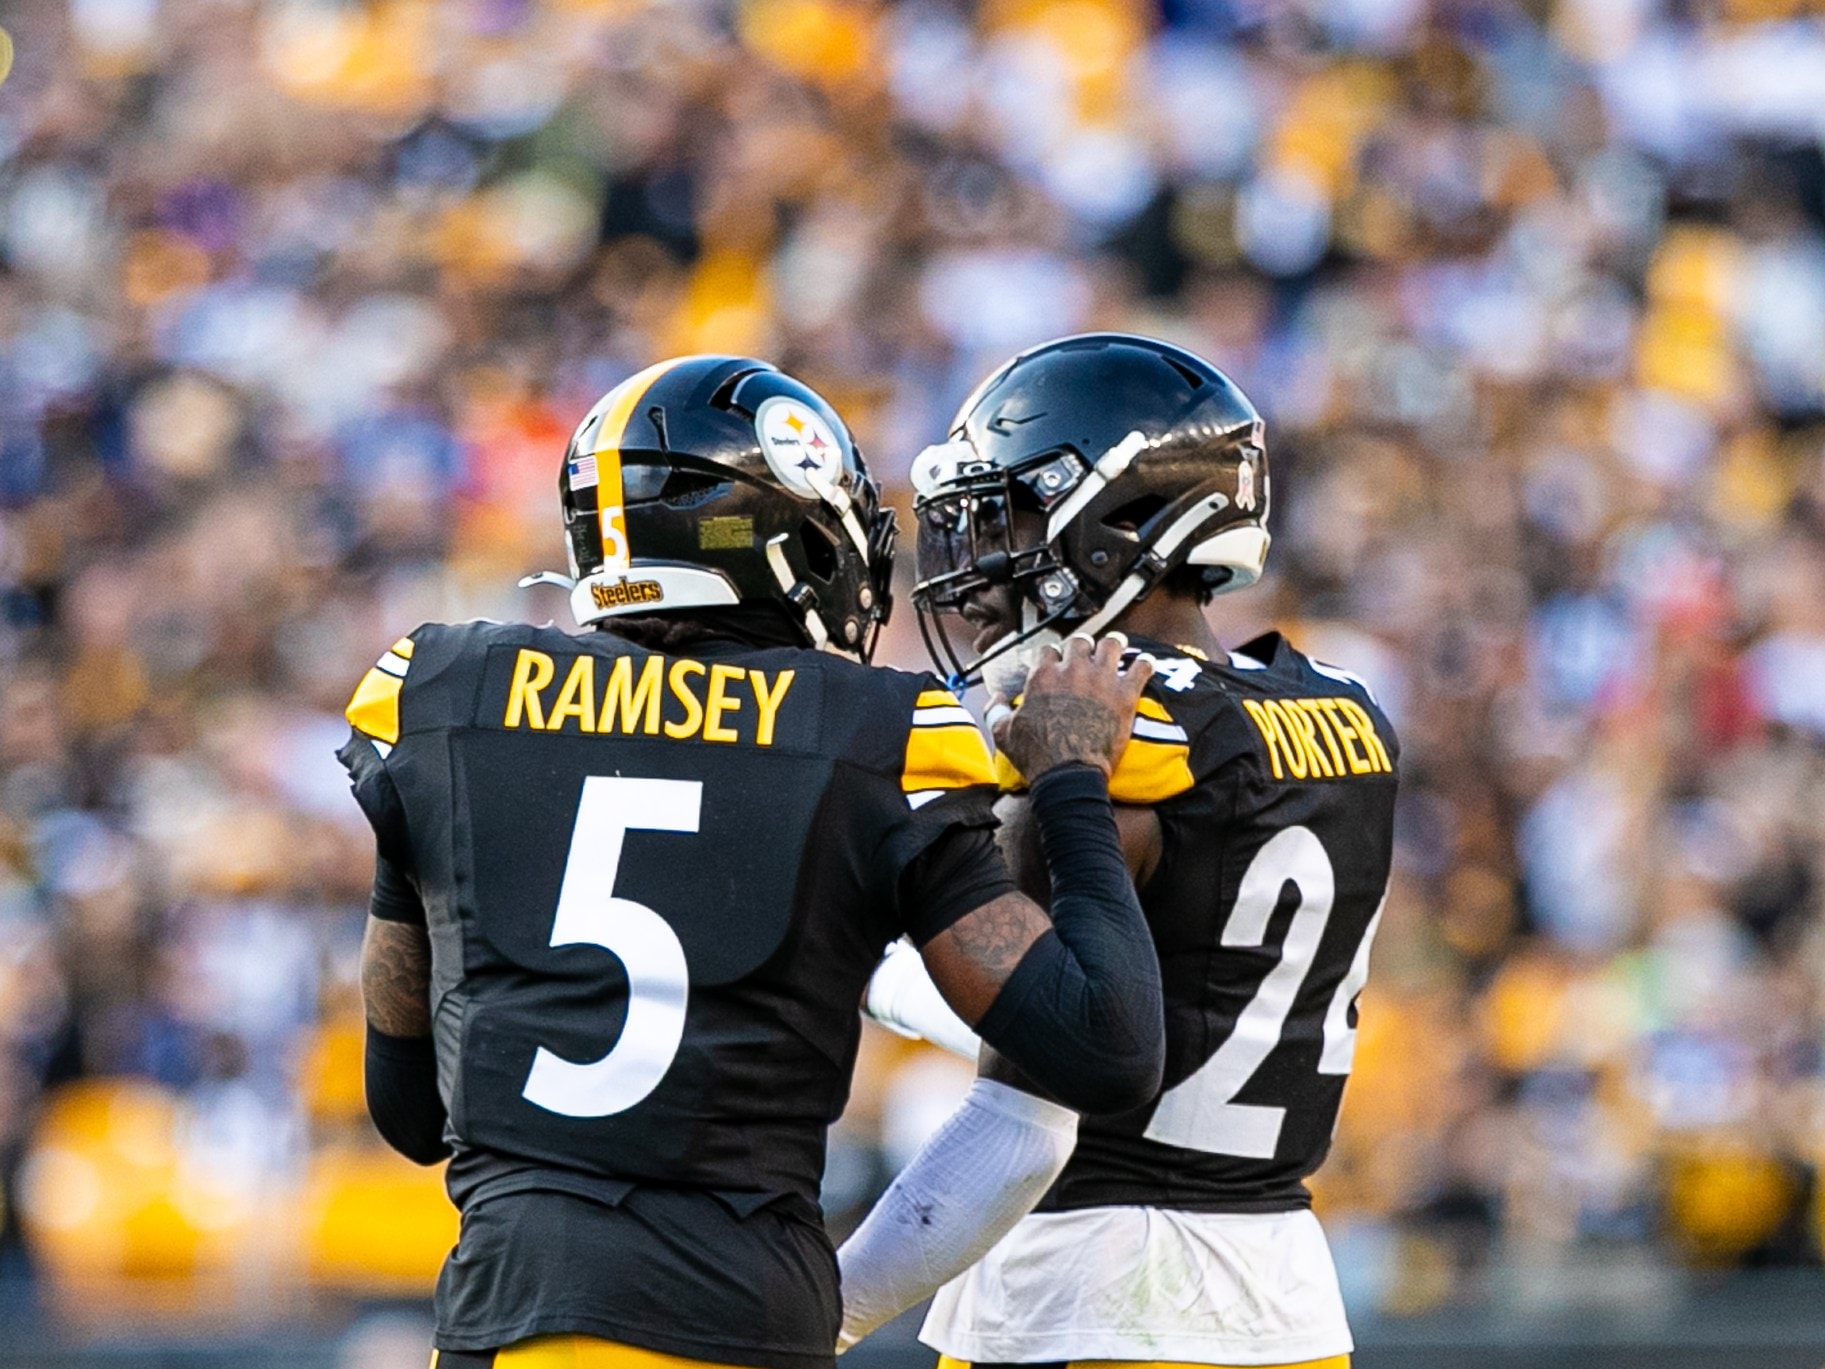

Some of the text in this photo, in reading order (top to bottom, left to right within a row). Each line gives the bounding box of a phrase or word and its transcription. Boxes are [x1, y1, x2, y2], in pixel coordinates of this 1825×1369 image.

[601, 505, 627, 567] 5
[591, 575, 664, 610] Steelers
[503, 648, 796, 746] RAMSEY
[1242, 697, 1393, 780] PORTER
[521, 775, 703, 1119] 5
